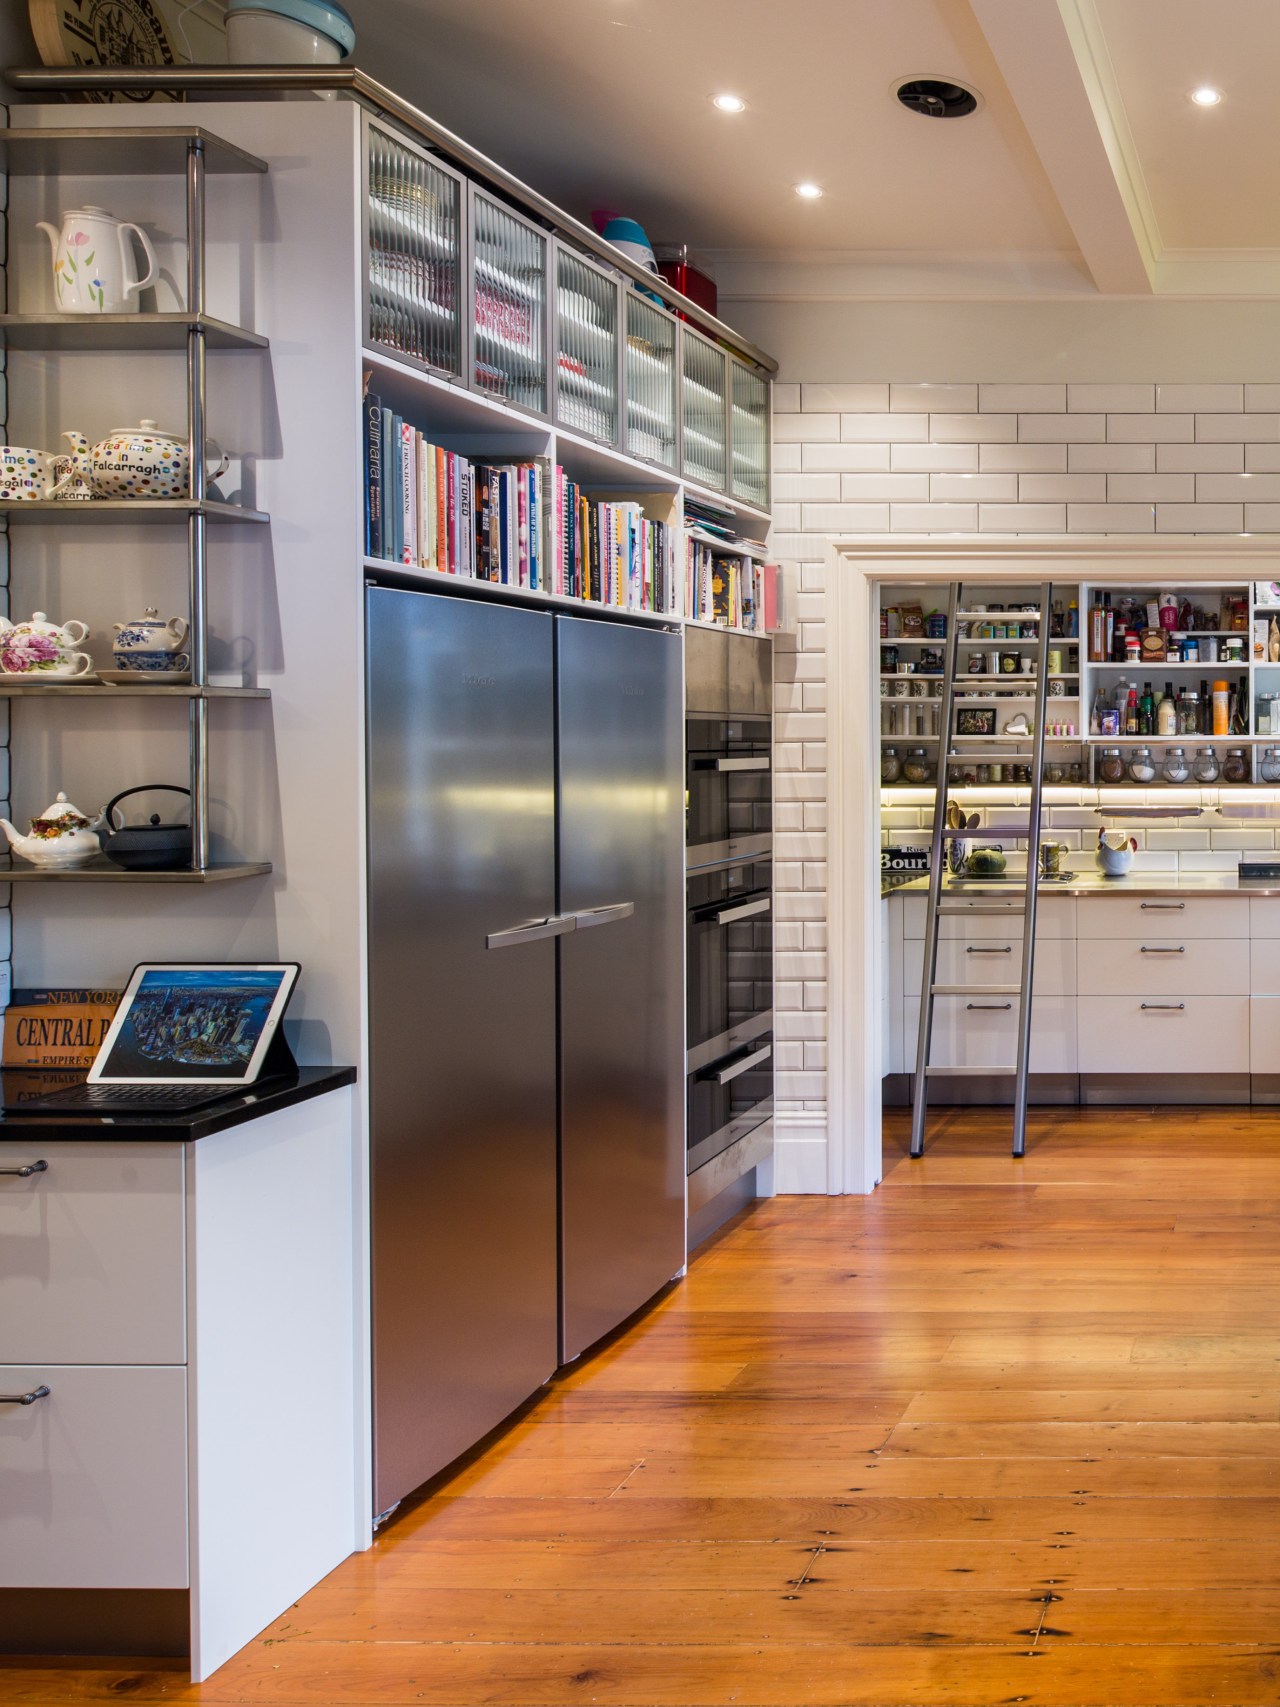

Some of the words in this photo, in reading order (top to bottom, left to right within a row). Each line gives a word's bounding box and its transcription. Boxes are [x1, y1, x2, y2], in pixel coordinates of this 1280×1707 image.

[102, 441, 121, 451] Tea
[369, 406, 381, 479] Culinaria
[118, 452, 129, 462] in
[93, 460, 161, 476] Falcarragh
[461, 473, 469, 517] STOKED
[47, 991, 84, 1005] NEW
[84, 991, 122, 1005] YORK
[16, 1018, 95, 1046] CENTRAL
[98, 1018, 113, 1047] P
[42, 1055, 82, 1065] EMPIRE
[83, 1055, 96, 1065] ST
